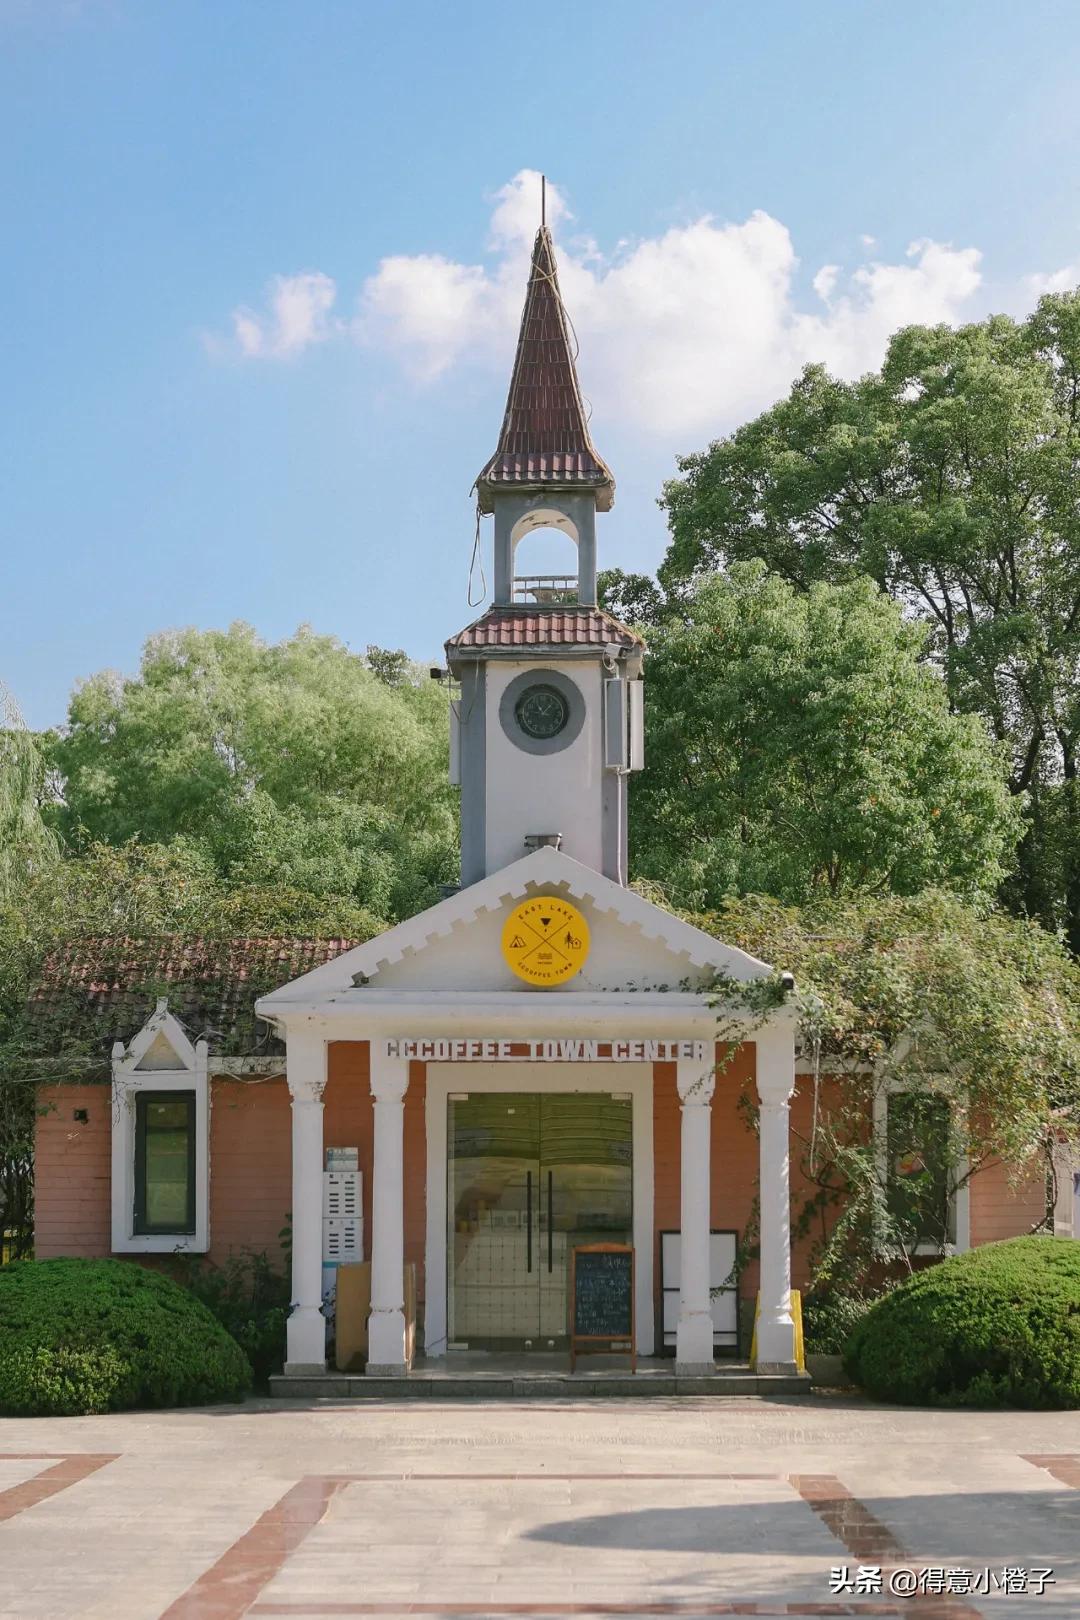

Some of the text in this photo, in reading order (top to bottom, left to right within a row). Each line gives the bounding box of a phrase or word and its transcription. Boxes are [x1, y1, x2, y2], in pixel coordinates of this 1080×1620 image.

[518, 904, 574, 921] EAST LAKE
[555, 962, 573, 977] TOWN
[529, 1038, 598, 1062] TOWN
[611, 1038, 708, 1062] CENTER
